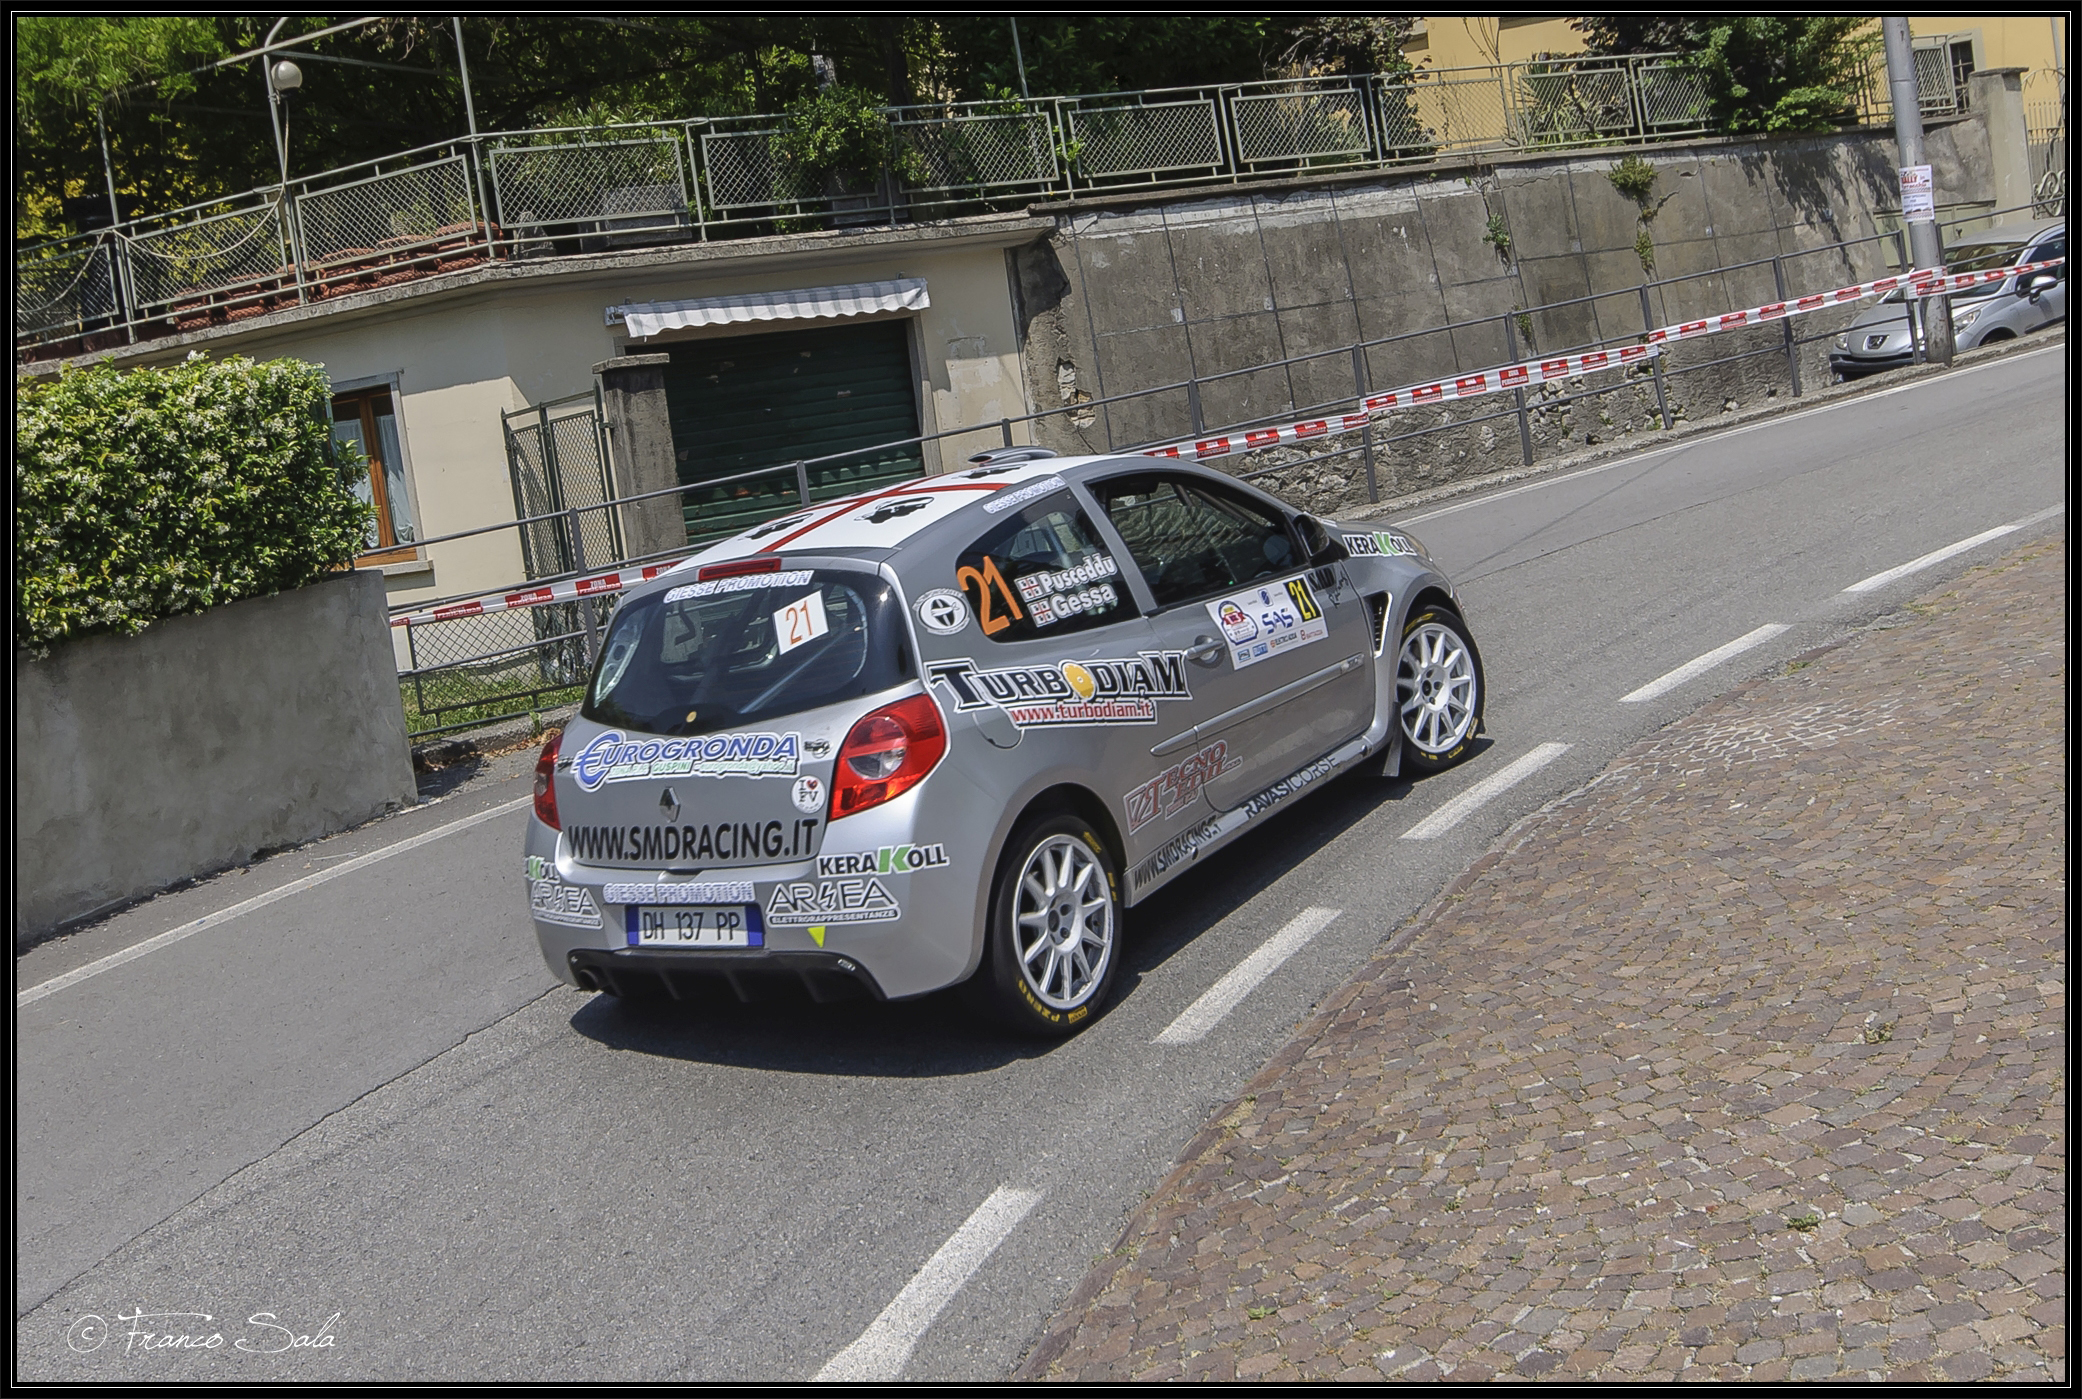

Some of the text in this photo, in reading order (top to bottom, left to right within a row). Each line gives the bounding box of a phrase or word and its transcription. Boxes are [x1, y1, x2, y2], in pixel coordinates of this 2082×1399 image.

[1343, 532, 1416, 556] KERAKOLL
[664, 570, 814, 604] GIESSE PROMOTION
[1039, 553, 1118, 593] Pusceddu
[957, 556, 1023, 636] 21
[1051, 585, 1118, 619] Gessa
[1288, 579, 1317, 620] 21
[785, 600, 814, 646] 21
[1012, 702, 1153, 722] www.turbodiam.it
[652, 761, 692, 774] GUSPINI
[568, 819, 818, 861] WWW.SMDRACING.IT
[819, 846, 947, 877] KERAKOLL
[656, 881, 756, 903] PROMOTION
[643, 911, 740, 941] DH 137 PP
